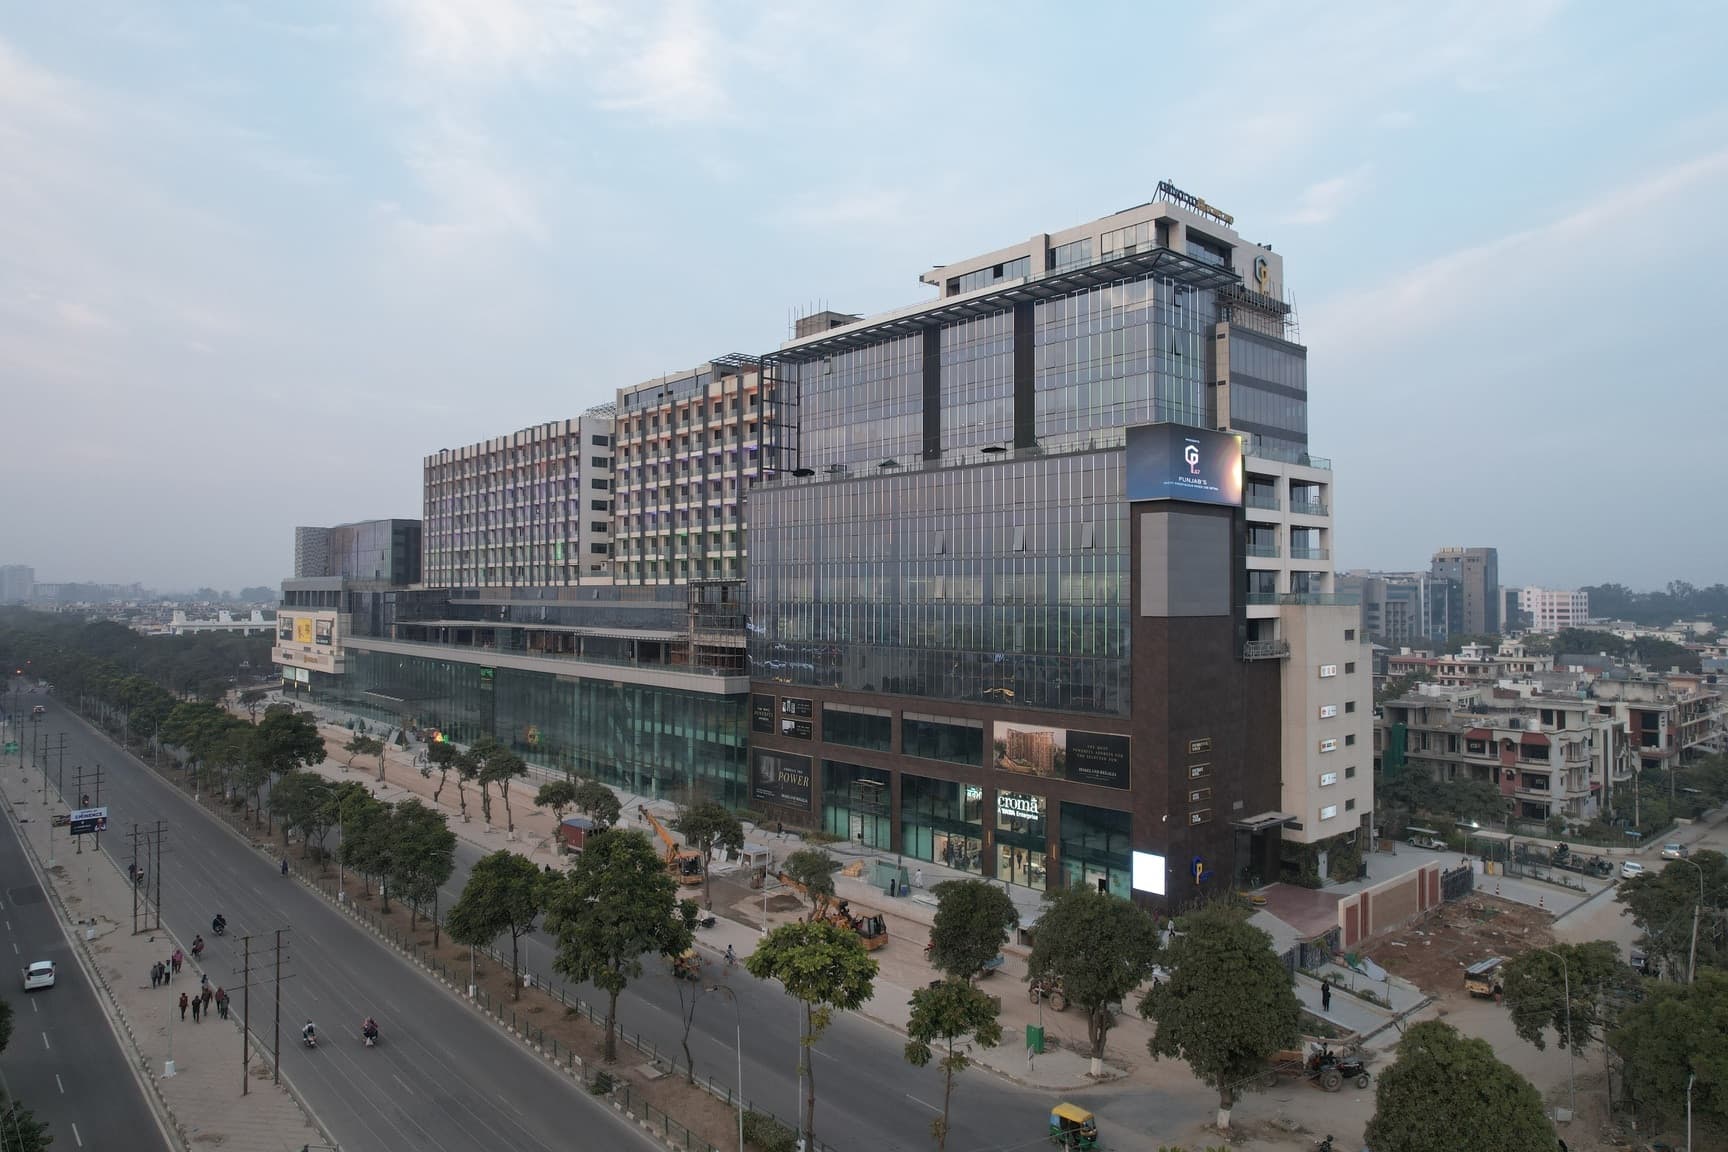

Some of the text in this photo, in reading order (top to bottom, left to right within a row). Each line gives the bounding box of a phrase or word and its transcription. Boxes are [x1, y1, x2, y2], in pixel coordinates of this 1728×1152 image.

[1178, 476, 1208, 485] PUNJAB'S
[778, 771, 809, 788] POWER
[1001, 808, 1015, 816] TATA
[1016, 810, 1038, 821] Enterprise
